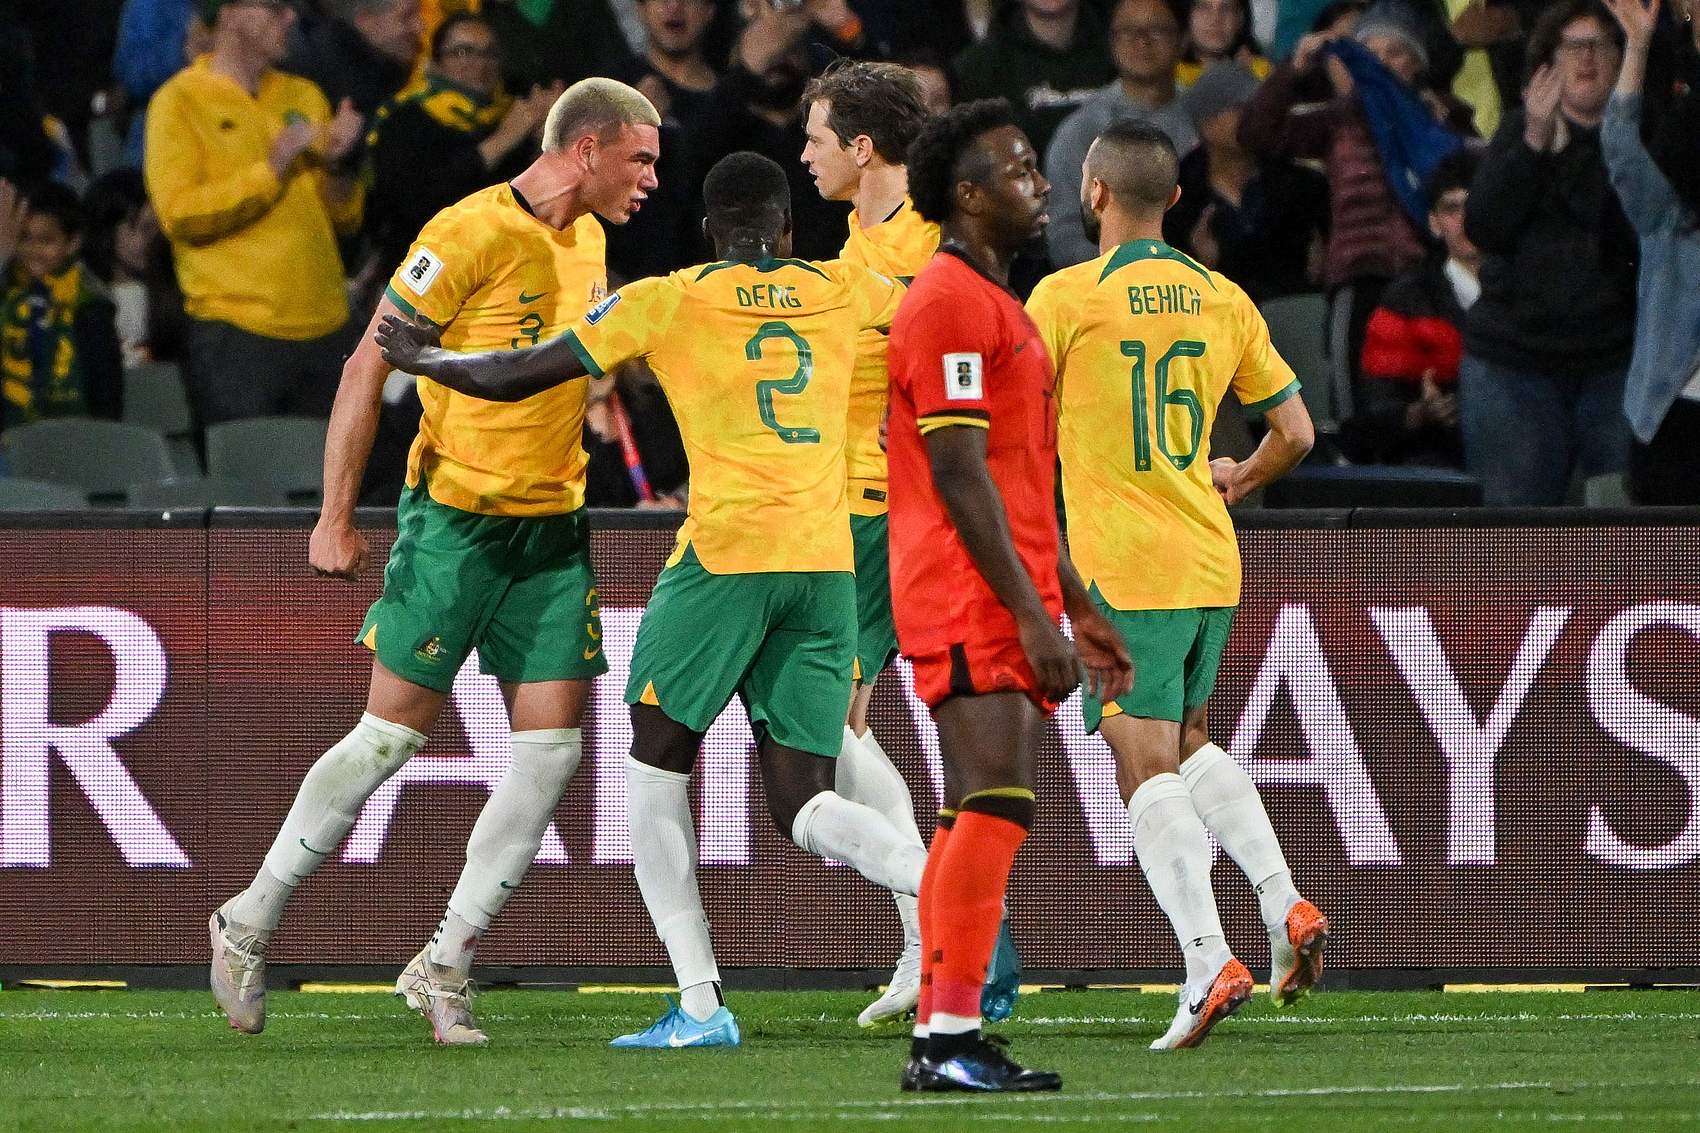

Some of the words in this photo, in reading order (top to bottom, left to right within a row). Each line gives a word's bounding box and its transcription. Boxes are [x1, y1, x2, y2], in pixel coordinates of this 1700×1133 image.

[735, 283, 803, 309] DENG
[1127, 284, 1202, 316] BEHICH
[744, 321, 821, 444] 2
[1119, 340, 1206, 472] 16
[0, 606, 192, 869] R
[342, 601, 1700, 870] AIAYS
